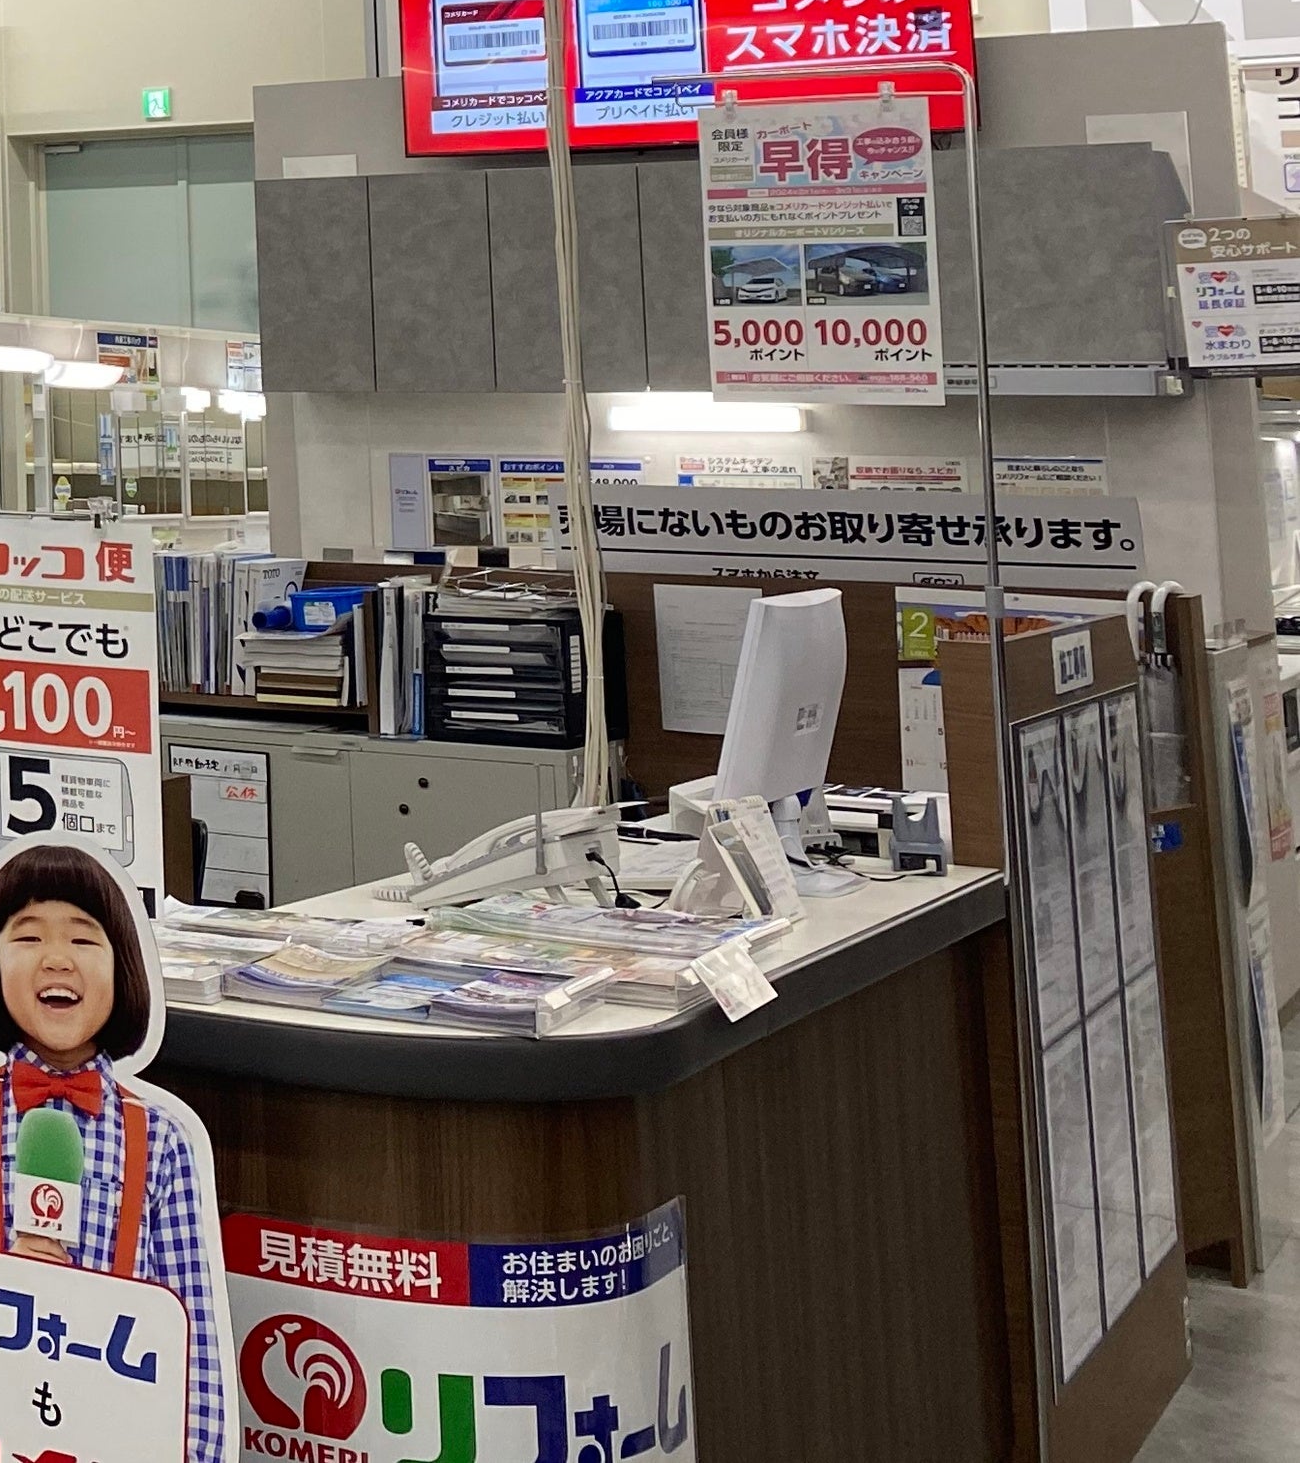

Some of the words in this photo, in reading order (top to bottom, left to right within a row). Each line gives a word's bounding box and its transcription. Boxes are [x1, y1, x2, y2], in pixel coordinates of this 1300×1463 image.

[726, 11, 953, 62] スマホ決済
[717, 141, 744, 153] 限定
[759, 138, 854, 183] 早得
[1209, 228, 1251, 243] 2つの
[1210, 241, 1298, 258] 安心サポート
[713, 319, 804, 348] 5,000
[814, 318, 928, 348] 10,000
[749, 348, 805, 362] ポイント
[874, 347, 933, 362] ポイント
[909, 611, 929, 638] 2
[6, 754, 57, 836] 5
[30, 1217, 63, 1231] コメリ
[258, 1228, 443, 1298] 見積無料
[502, 1224, 675, 1276] お住まいのお困りごと、
[502, 1269, 628, 1304] 解決します!
[32, 1381, 62, 1427] も
